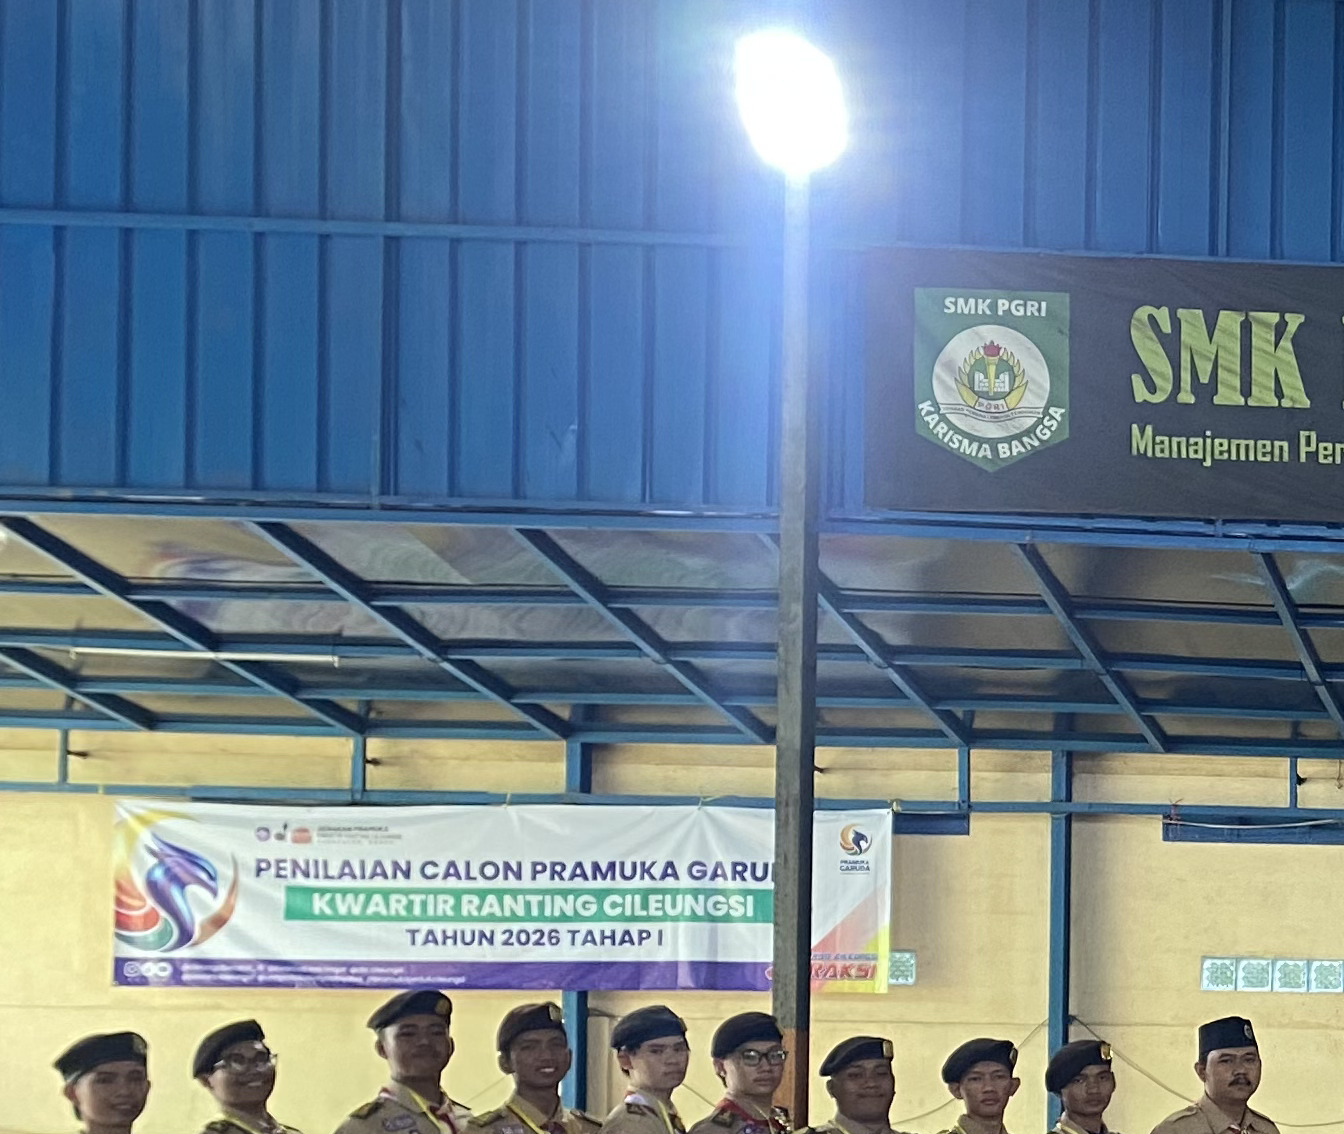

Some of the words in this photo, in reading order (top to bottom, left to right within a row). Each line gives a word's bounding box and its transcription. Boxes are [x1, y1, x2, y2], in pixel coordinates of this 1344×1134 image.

[944, 297, 991, 315] SMK
[997, 299, 1047, 317] PGRI
[1129, 305, 1311, 409] SMK
[917, 400, 992, 459] KARISMA
[997, 406, 1065, 459] BANGSA
[1130, 424, 1289, 467] Manajemen
[255, 858, 411, 881] PENILAIAN
[420, 860, 525, 882] CALON
[530, 860, 680, 882] PRAMUKA
[686, 861, 774, 882] GARU
[312, 891, 457, 917] KWARTIR
[462, 892, 597, 918] RANTING
[603, 893, 754, 919] CILEUNGSI
[406, 928, 495, 947] TAHUN
[500, 928, 560, 948] 2026
[567, 928, 653, 948] TAHAP
